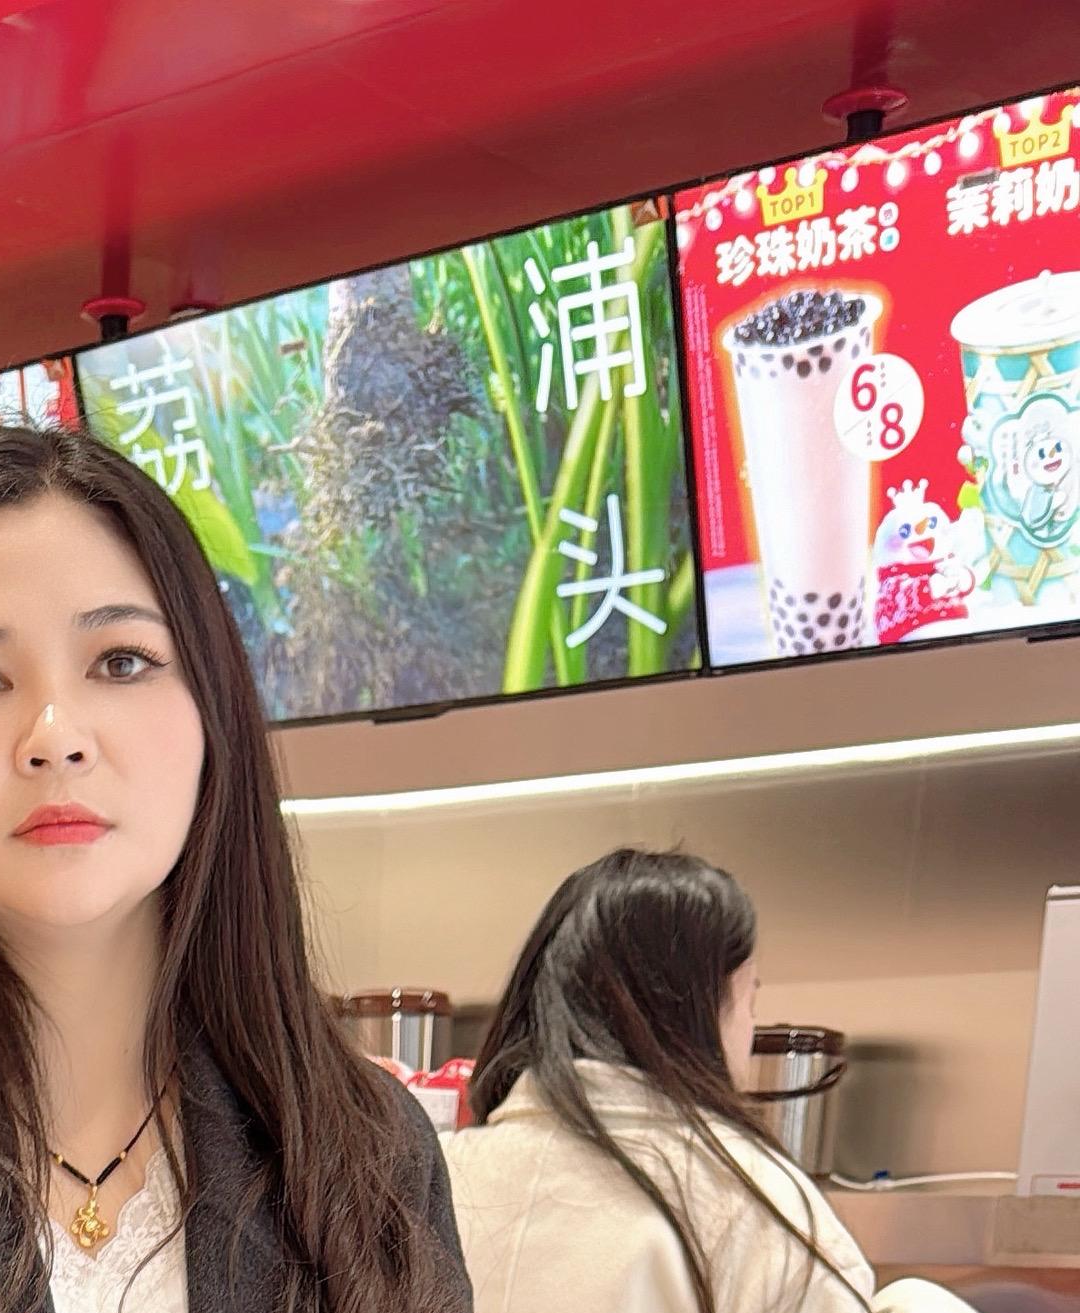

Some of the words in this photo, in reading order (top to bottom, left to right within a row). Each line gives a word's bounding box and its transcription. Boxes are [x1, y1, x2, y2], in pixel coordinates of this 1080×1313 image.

[1009, 131, 1062, 158] TOP2
[770, 191, 815, 218] TOP1
[946, 157, 1080, 236] 茉莉奶
[715, 204, 878, 287] 珍珠奶茶
[523, 236, 647, 413] 浦
[850, 363, 878, 413] 6
[879, 402, 906, 451] 8
[556, 494, 667, 648] 头
